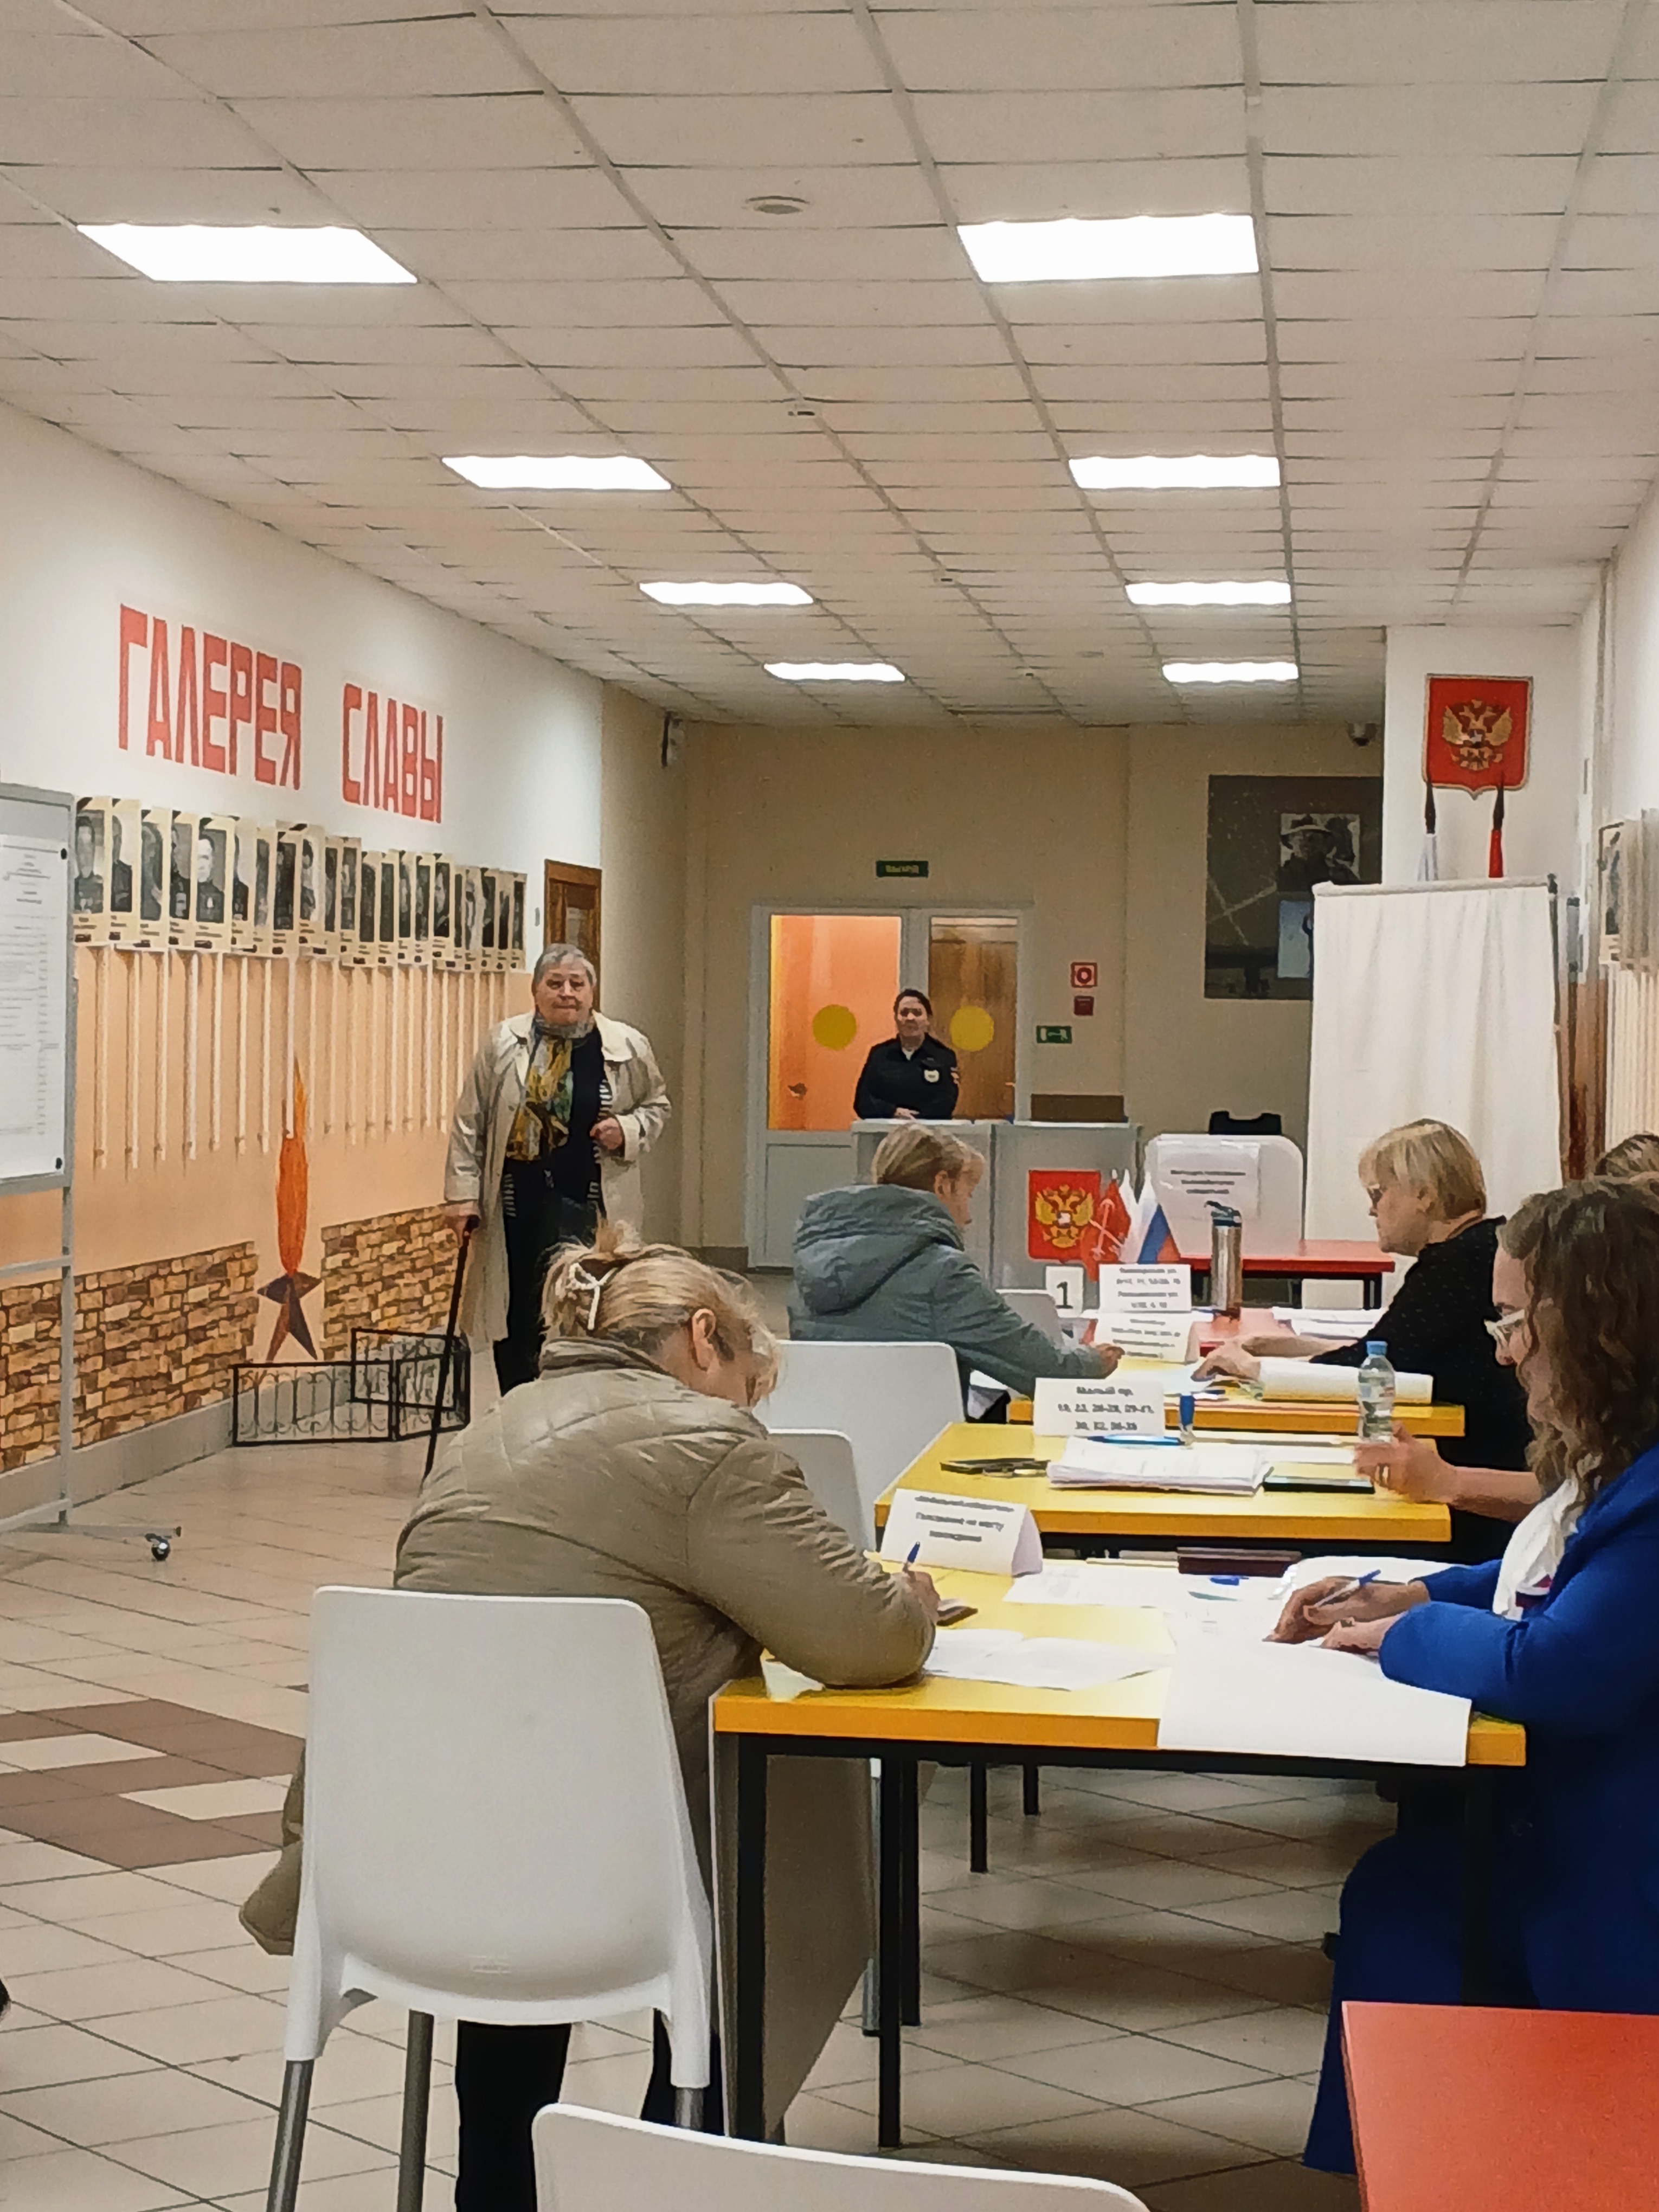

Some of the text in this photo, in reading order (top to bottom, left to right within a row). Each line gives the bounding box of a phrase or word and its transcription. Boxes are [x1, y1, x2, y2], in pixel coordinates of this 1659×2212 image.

[118, 603, 443, 824] ГАЛЕРЕЯ СЛАВЫ
[1056, 1281, 1073, 1309] 1
